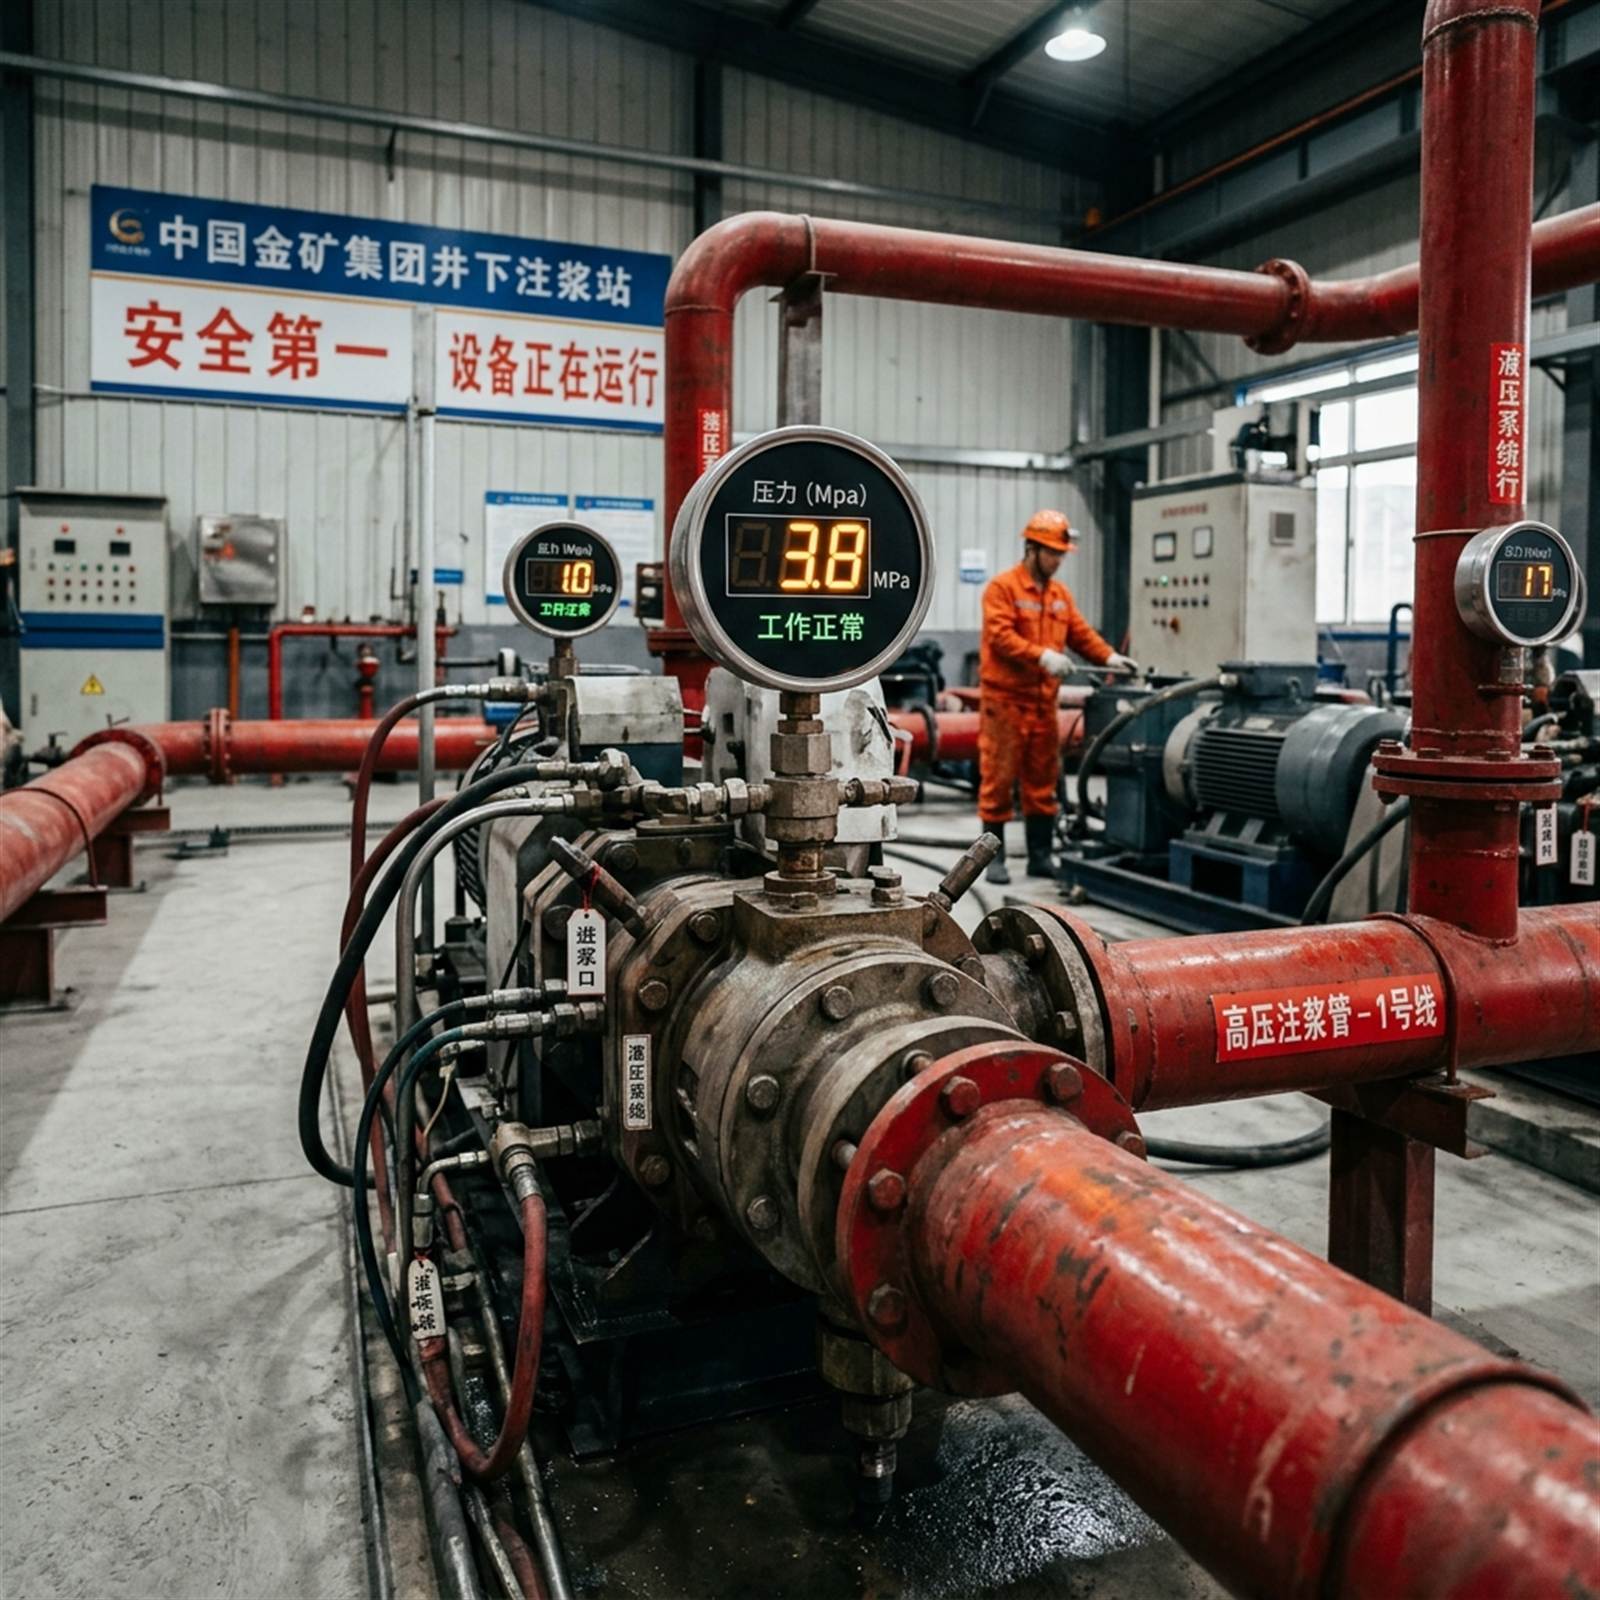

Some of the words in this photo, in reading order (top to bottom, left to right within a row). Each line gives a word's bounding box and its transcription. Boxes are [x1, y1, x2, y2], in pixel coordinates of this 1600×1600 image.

[159, 214, 633, 308] 中国金矿集团井下注浆站
[124, 300, 388, 380] 安全第一
[449, 333, 658, 408] 设备正在运行
[752, 480, 797, 504] 压力
[806, 482, 867, 508] (Mpa)
[780, 522, 866, 589] 3.8
[873, 571, 910, 588] MPa
[757, 613, 865, 641] 工作正常
[1222, 985, 1438, 1051] 高压注浆管-1号线
